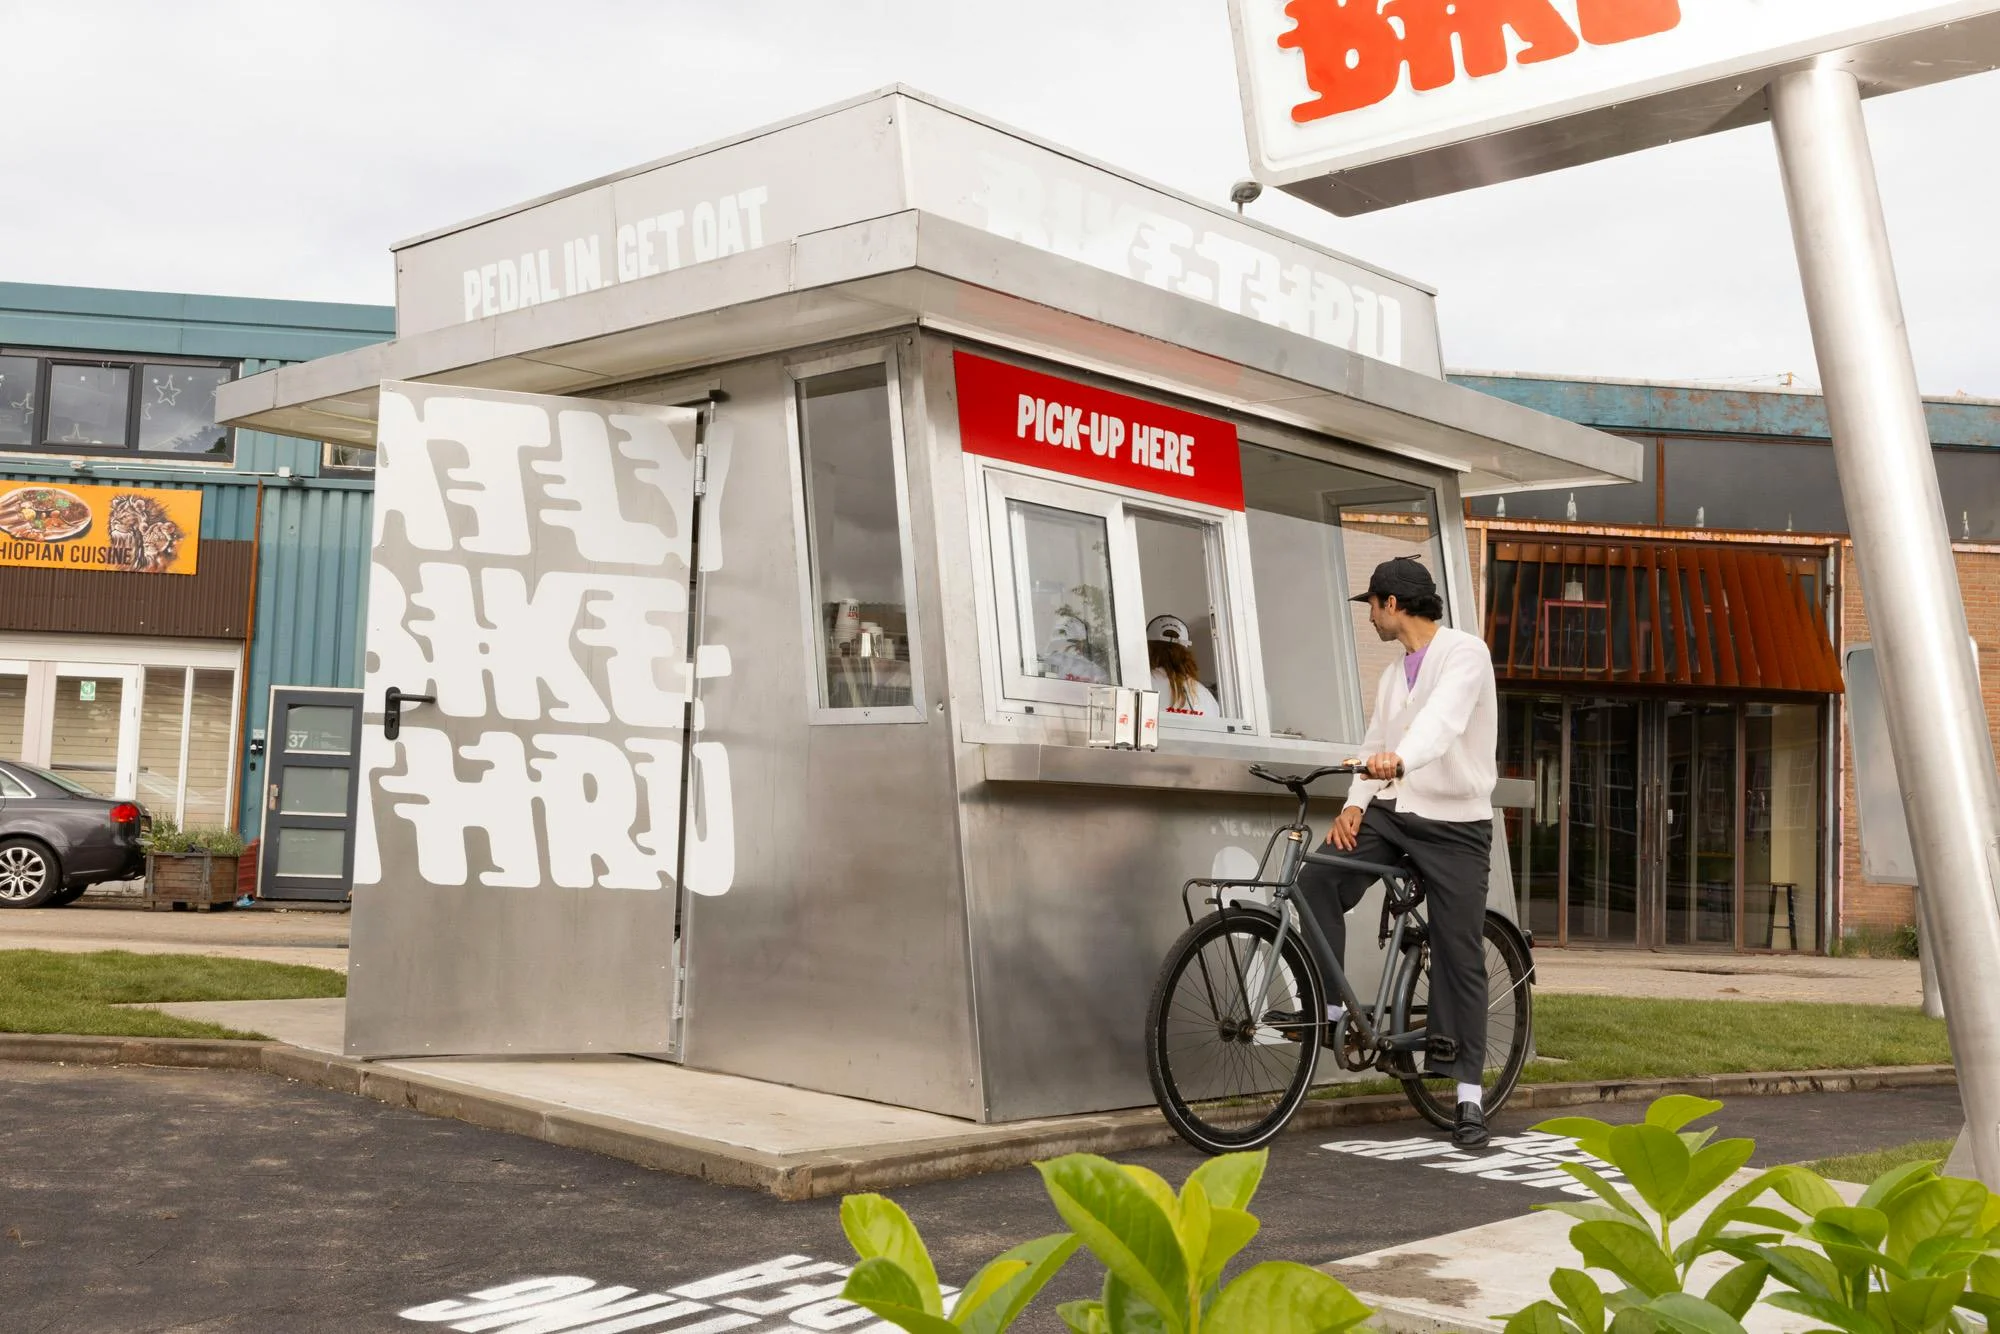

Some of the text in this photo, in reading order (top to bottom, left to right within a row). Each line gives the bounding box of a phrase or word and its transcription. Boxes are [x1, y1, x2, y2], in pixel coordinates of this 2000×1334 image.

[463, 249, 559, 322] PEDAL
[617, 209, 685, 284] GET
[692, 185, 768, 264] OAT
[1017, 394, 1195, 477] PICK-UP HERE
[70, 545, 132, 565] CUISINE
[288, 734, 308, 748] 37
